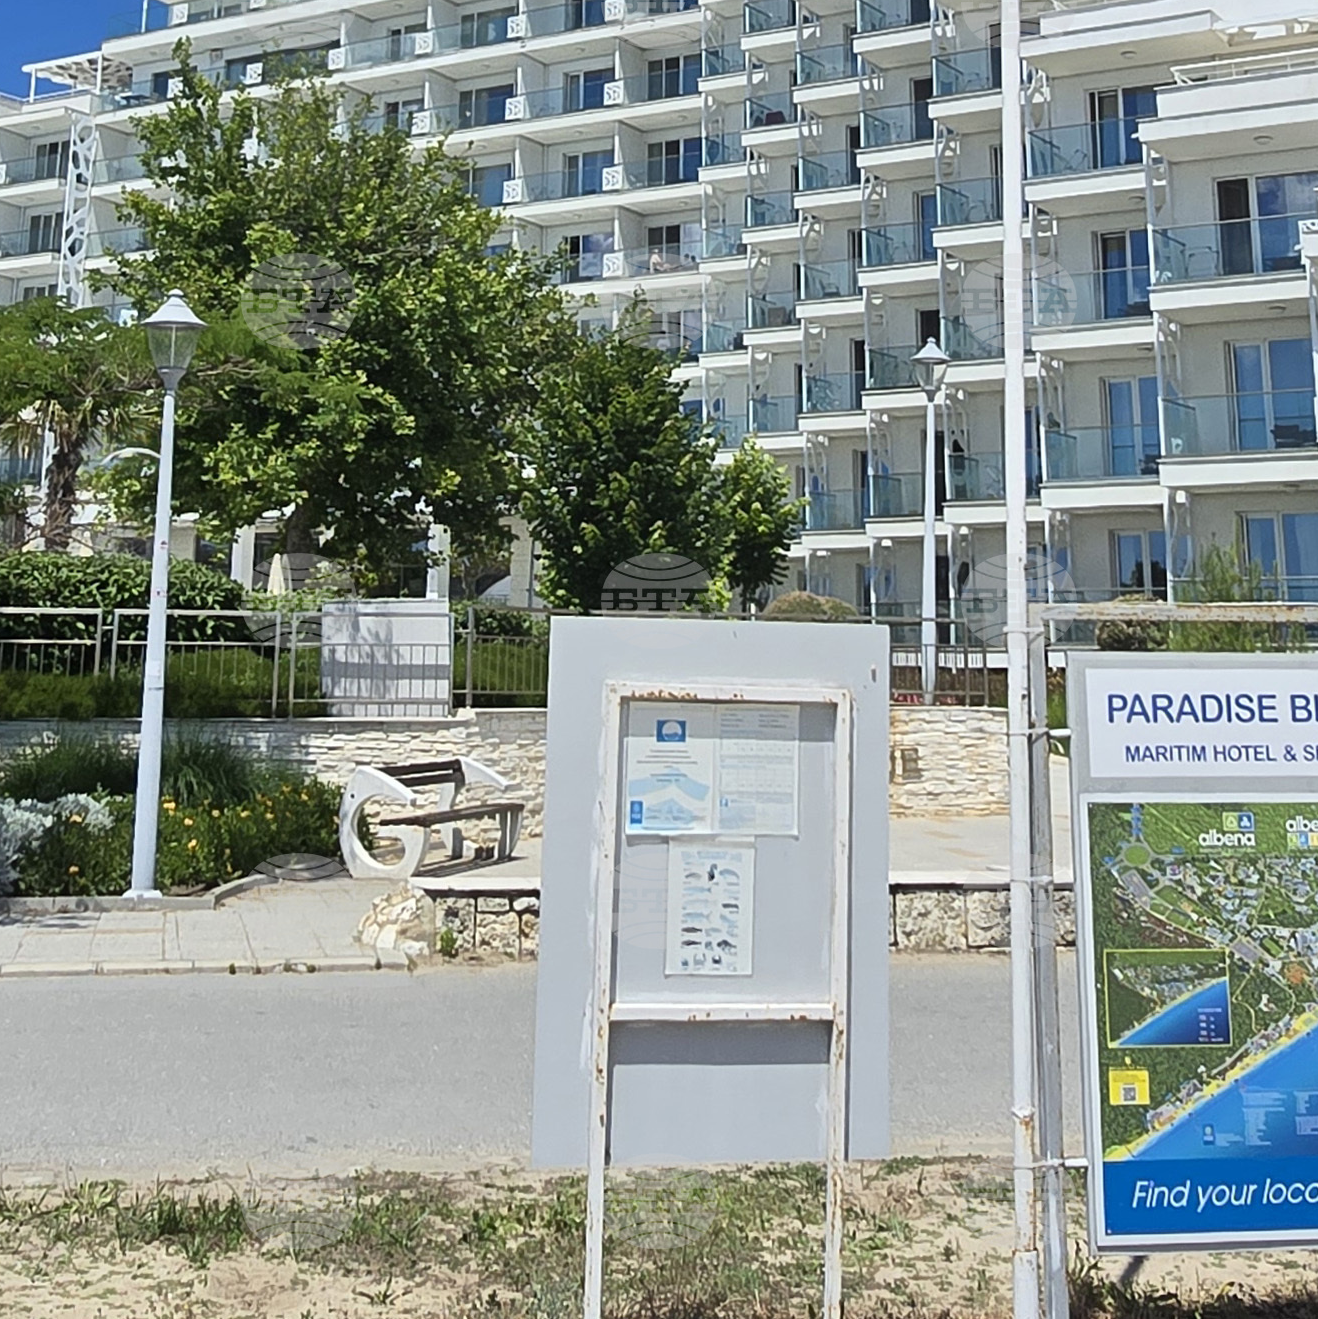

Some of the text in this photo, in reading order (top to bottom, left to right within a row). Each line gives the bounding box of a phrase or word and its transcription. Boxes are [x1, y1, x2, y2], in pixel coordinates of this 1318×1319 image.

[1107, 693, 1279, 724] PARADISE
[1125, 744, 1207, 763] MARITIM
[1212, 744, 1278, 763] HOTEL
[1283, 744, 1298, 762] &
[1198, 829, 1256, 847] albena
[1132, 1180, 1191, 1208] Find
[1197, 1183, 1258, 1213] your
